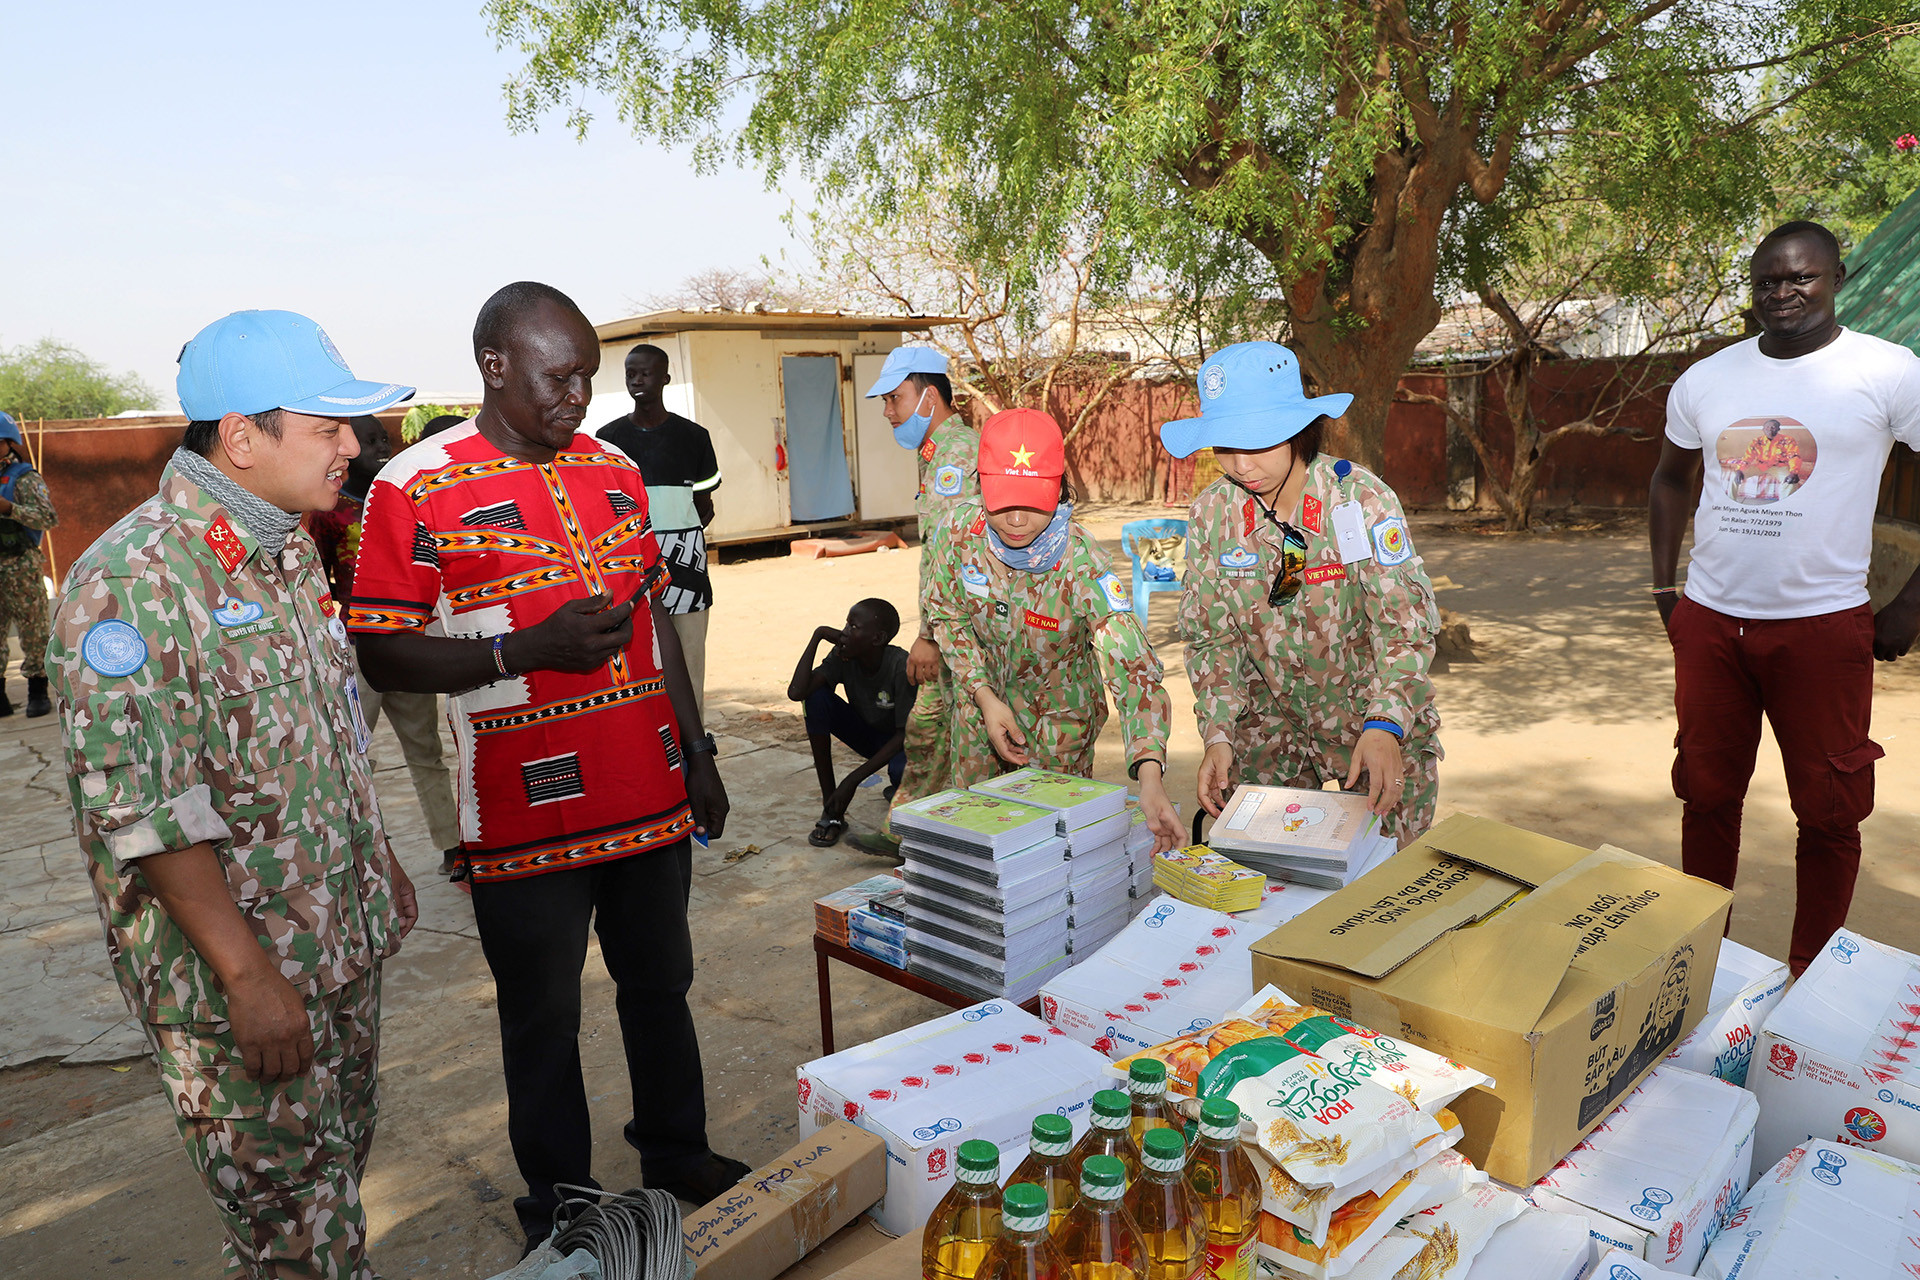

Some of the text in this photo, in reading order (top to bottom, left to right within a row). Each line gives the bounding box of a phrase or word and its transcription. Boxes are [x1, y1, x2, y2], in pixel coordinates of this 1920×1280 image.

[1005, 468, 1039, 477] Viet Nam
[1723, 505, 1739, 513] Miyen
[1740, 507, 1760, 515] Aguek
[1761, 509, 1783, 517] Miyen
[1731, 516, 1749, 524] Raise:
[1750, 518, 1782, 526] 7/2/1979
[1742, 528, 1781, 537] 19/11/2023
[1307, 567, 1345, 580] VIET NAM
[1027, 614, 1057, 630] VIET NAM
[1601, 911, 1630, 930] LÊN
[1620, 889, 1660, 914] THÙNG
[1117, 1032, 1135, 1043] HACCP
[1725, 1024, 1752, 1048] HOA
[1587, 1043, 1608, 1069] BÚT
[1305, 1061, 1325, 1076] 11
[1585, 1061, 1605, 1087] SÁP
[1818, 1077, 1833, 1087] NAM
[1068, 1102, 1084, 1113] HACCP
[1313, 1098, 1355, 1126] HOA
[1724, 1206, 1753, 1231] HOA
[1588, 1229, 1634, 1252] 9001:2015
